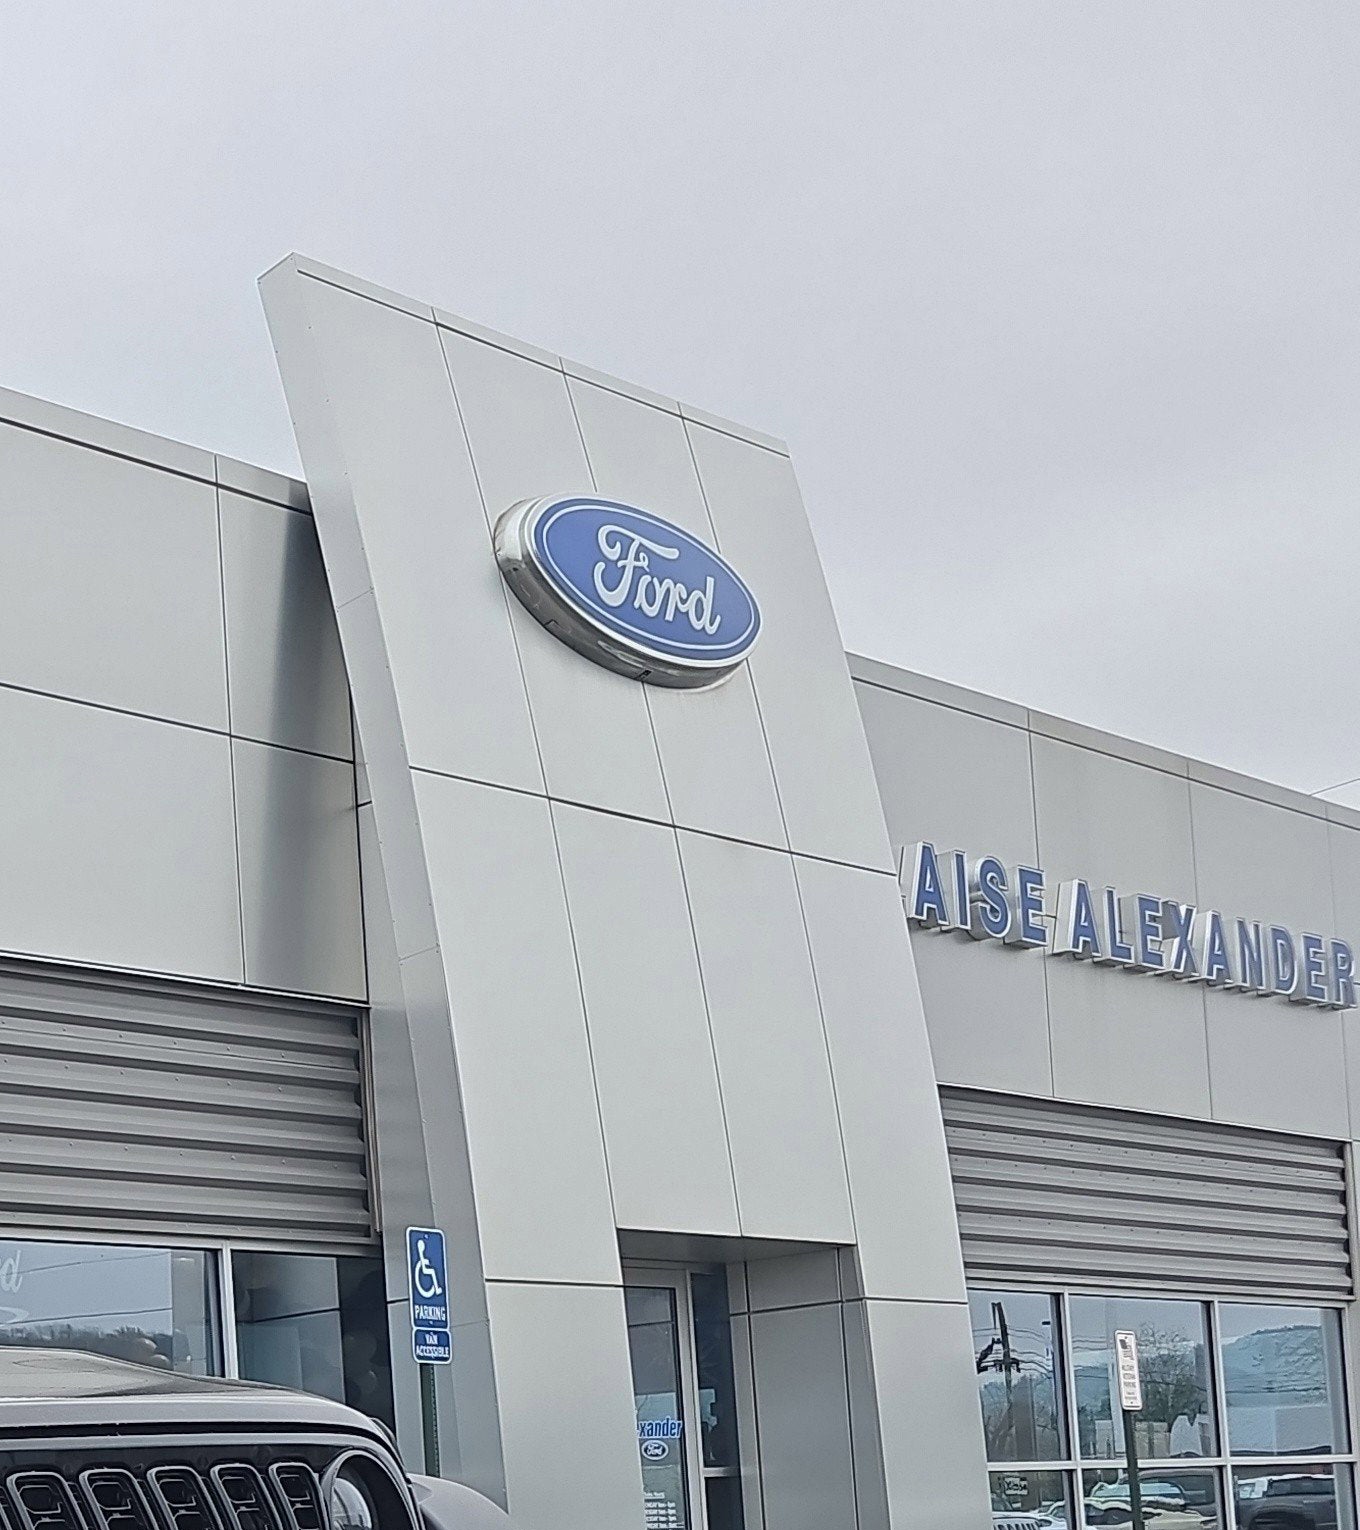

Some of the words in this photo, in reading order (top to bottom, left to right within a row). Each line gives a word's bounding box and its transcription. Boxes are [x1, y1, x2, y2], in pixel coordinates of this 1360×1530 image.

[593, 524, 721, 635] Ford
[1056, 878, 1359, 1008] ALEXANDER
[415, 1305, 446, 1321] PARKING
[425, 1333, 438, 1345] VAN
[416, 1345, 449, 1358] ACCESSIBLE
